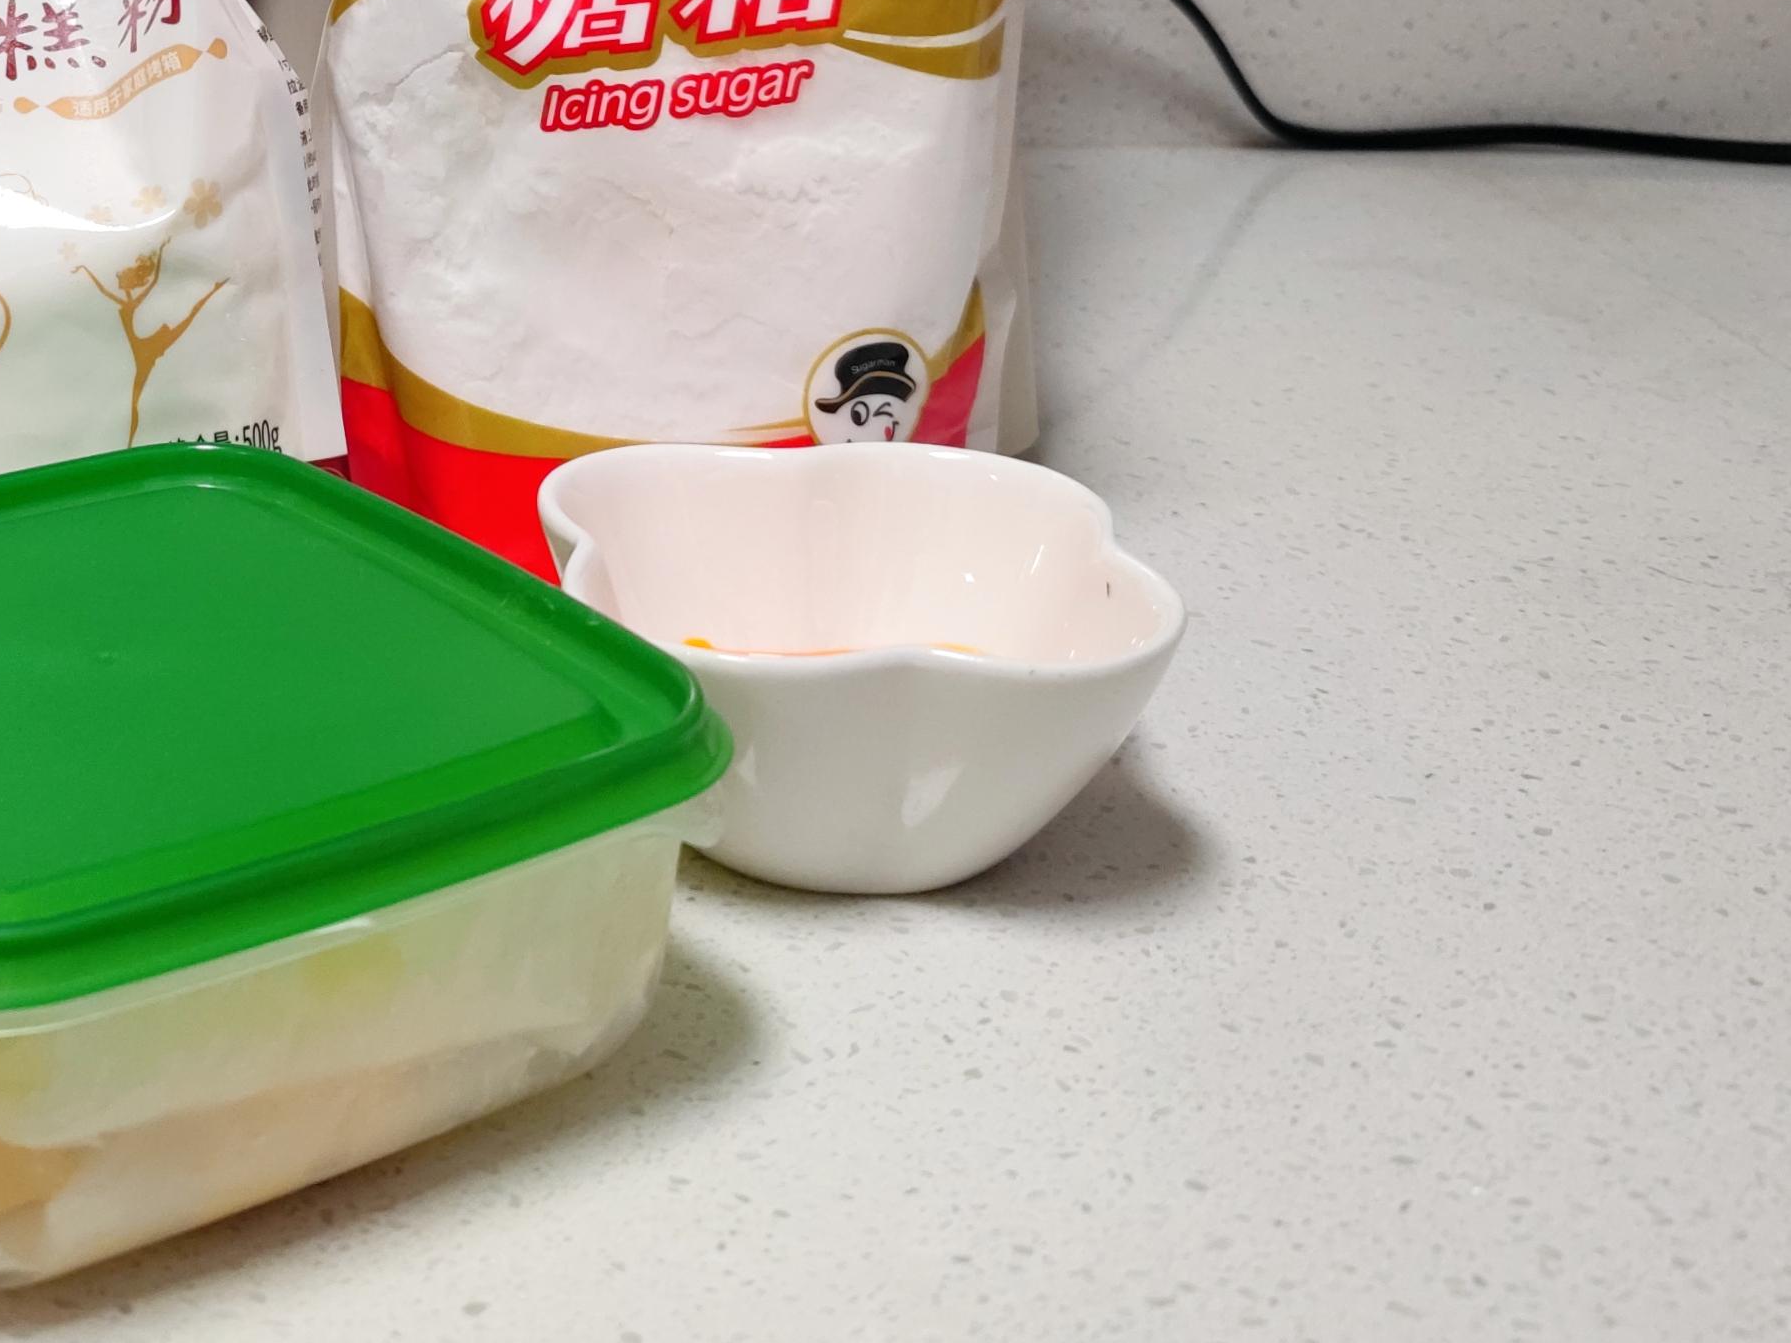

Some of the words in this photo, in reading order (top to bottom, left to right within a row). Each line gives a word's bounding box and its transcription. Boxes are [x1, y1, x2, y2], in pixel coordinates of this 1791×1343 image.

[543, 82, 661, 128] Icing
[671, 63, 810, 116] sugar
[850, 358, 896, 375] Sugarman
